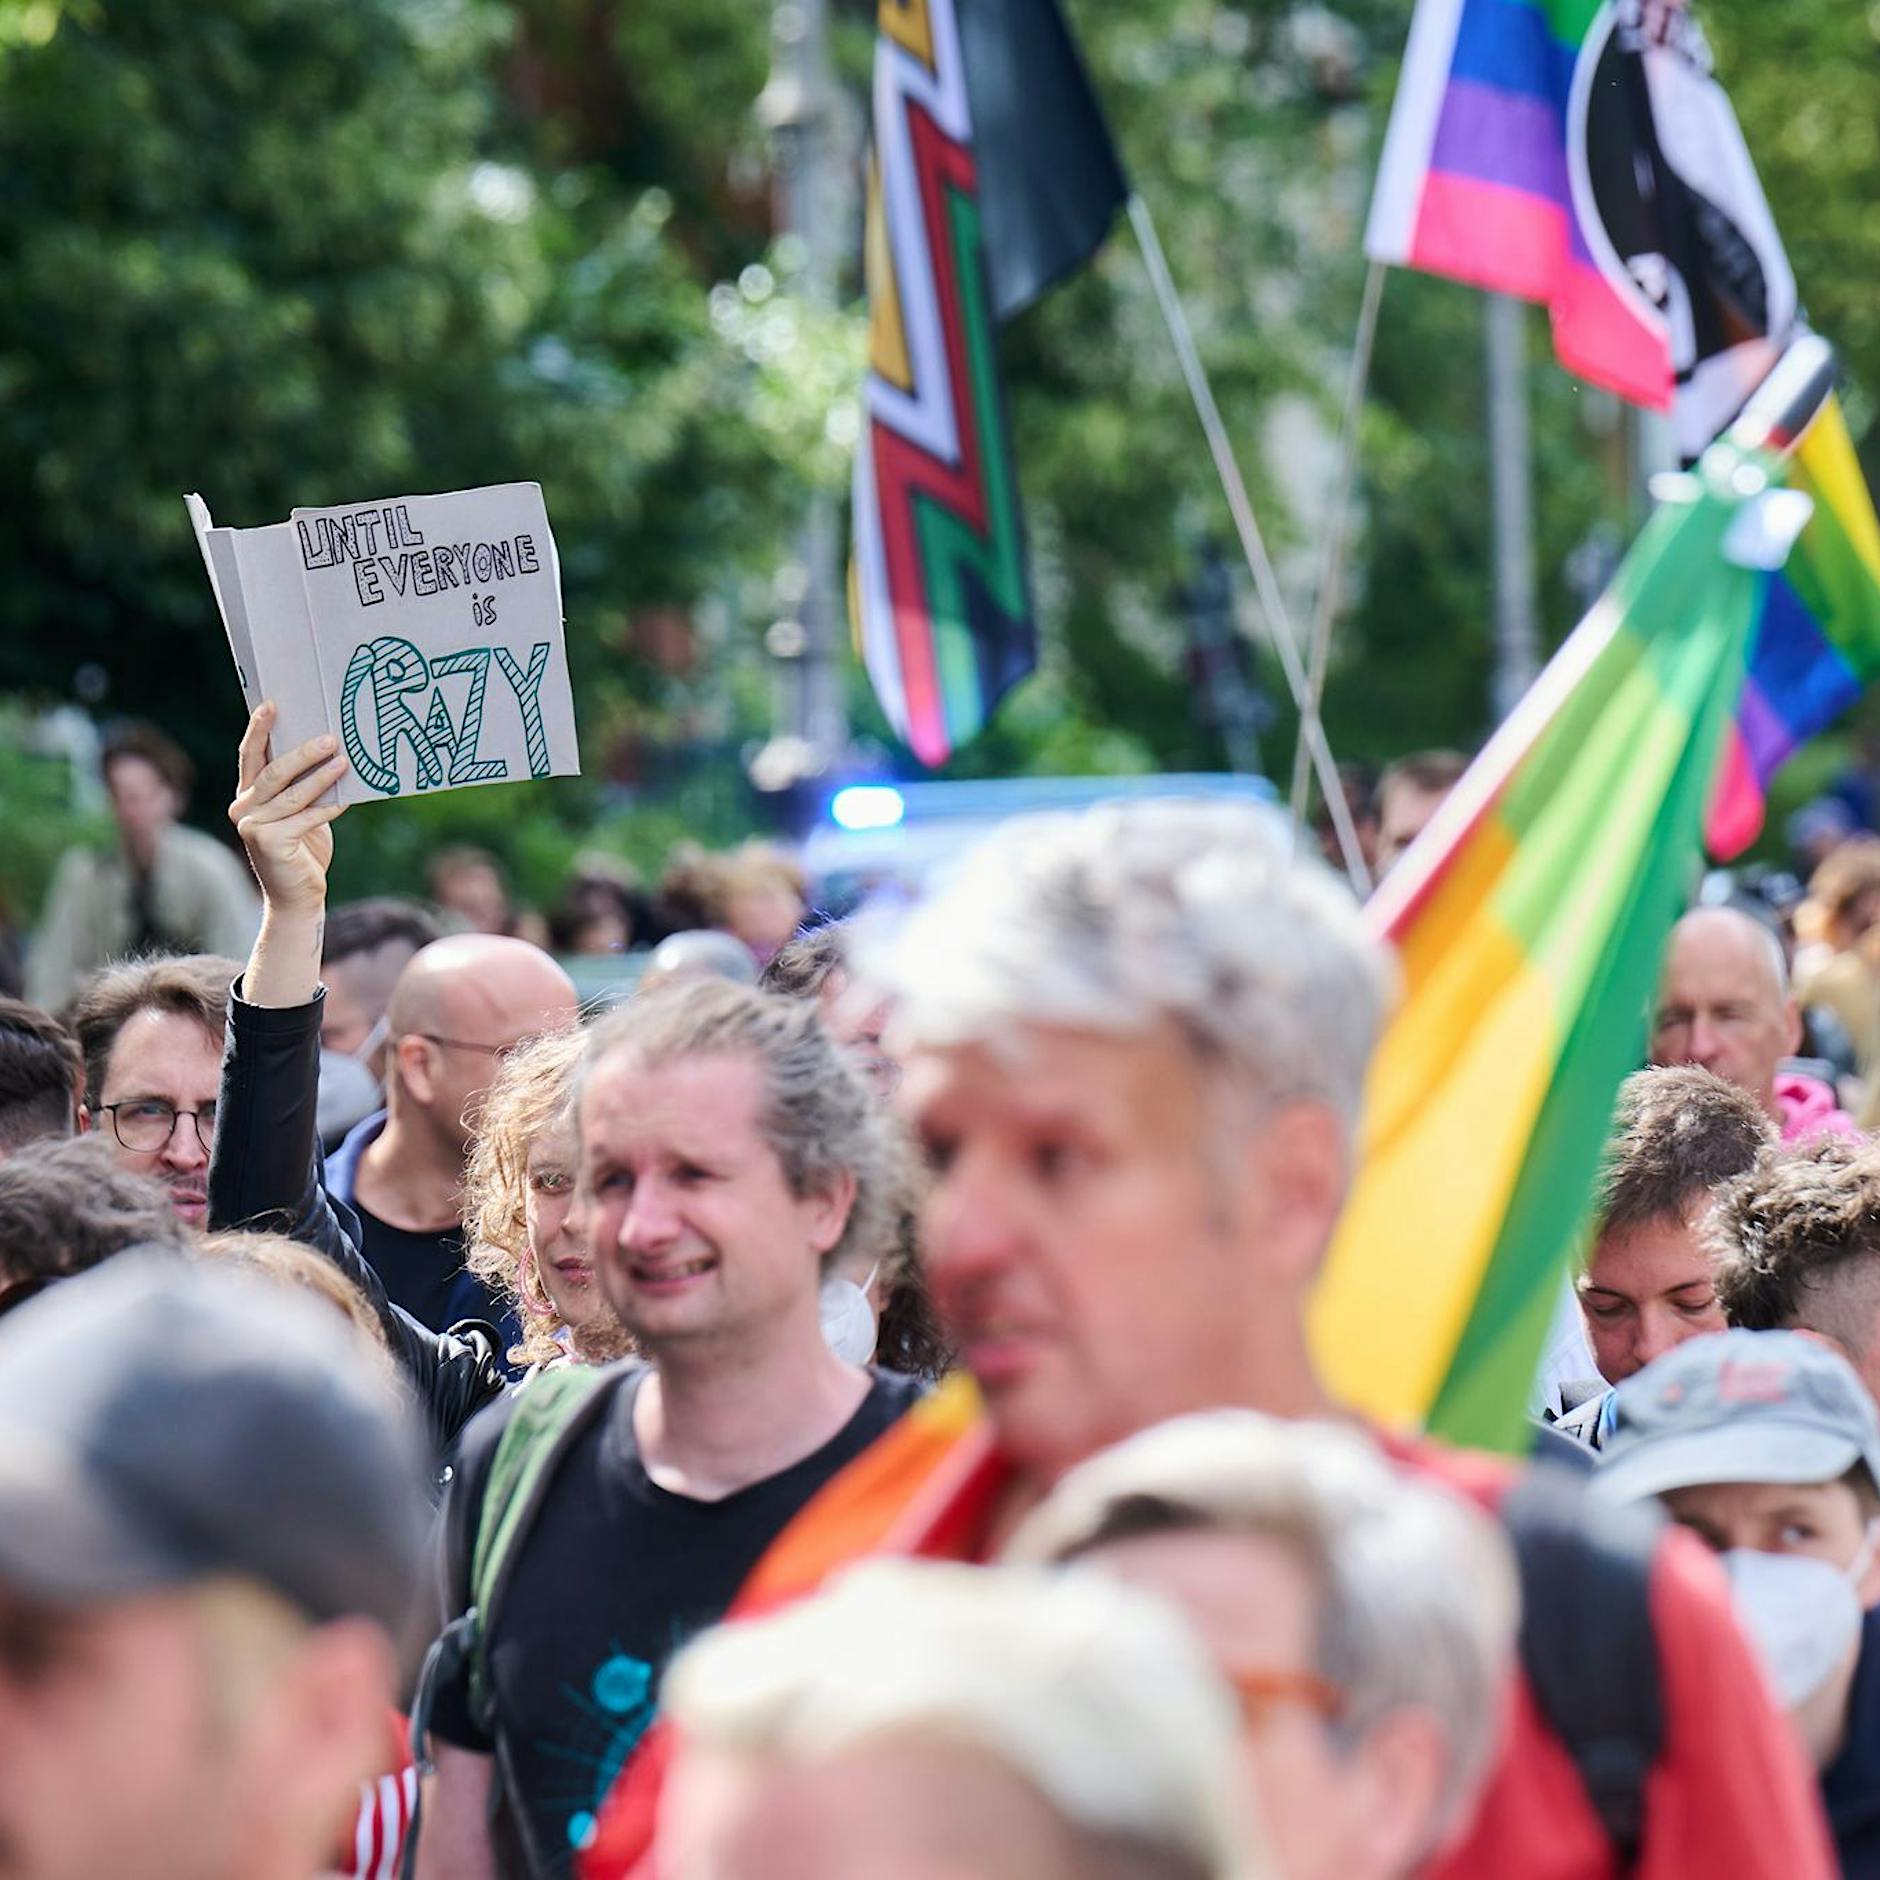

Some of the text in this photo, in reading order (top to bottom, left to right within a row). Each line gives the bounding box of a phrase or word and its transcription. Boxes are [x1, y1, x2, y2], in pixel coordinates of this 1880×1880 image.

[297, 505, 423, 570] UNTIL
[354, 535, 540, 606] EVERYONE
[472, 593, 497, 626] is
[341, 636, 551, 794] CRAZY
